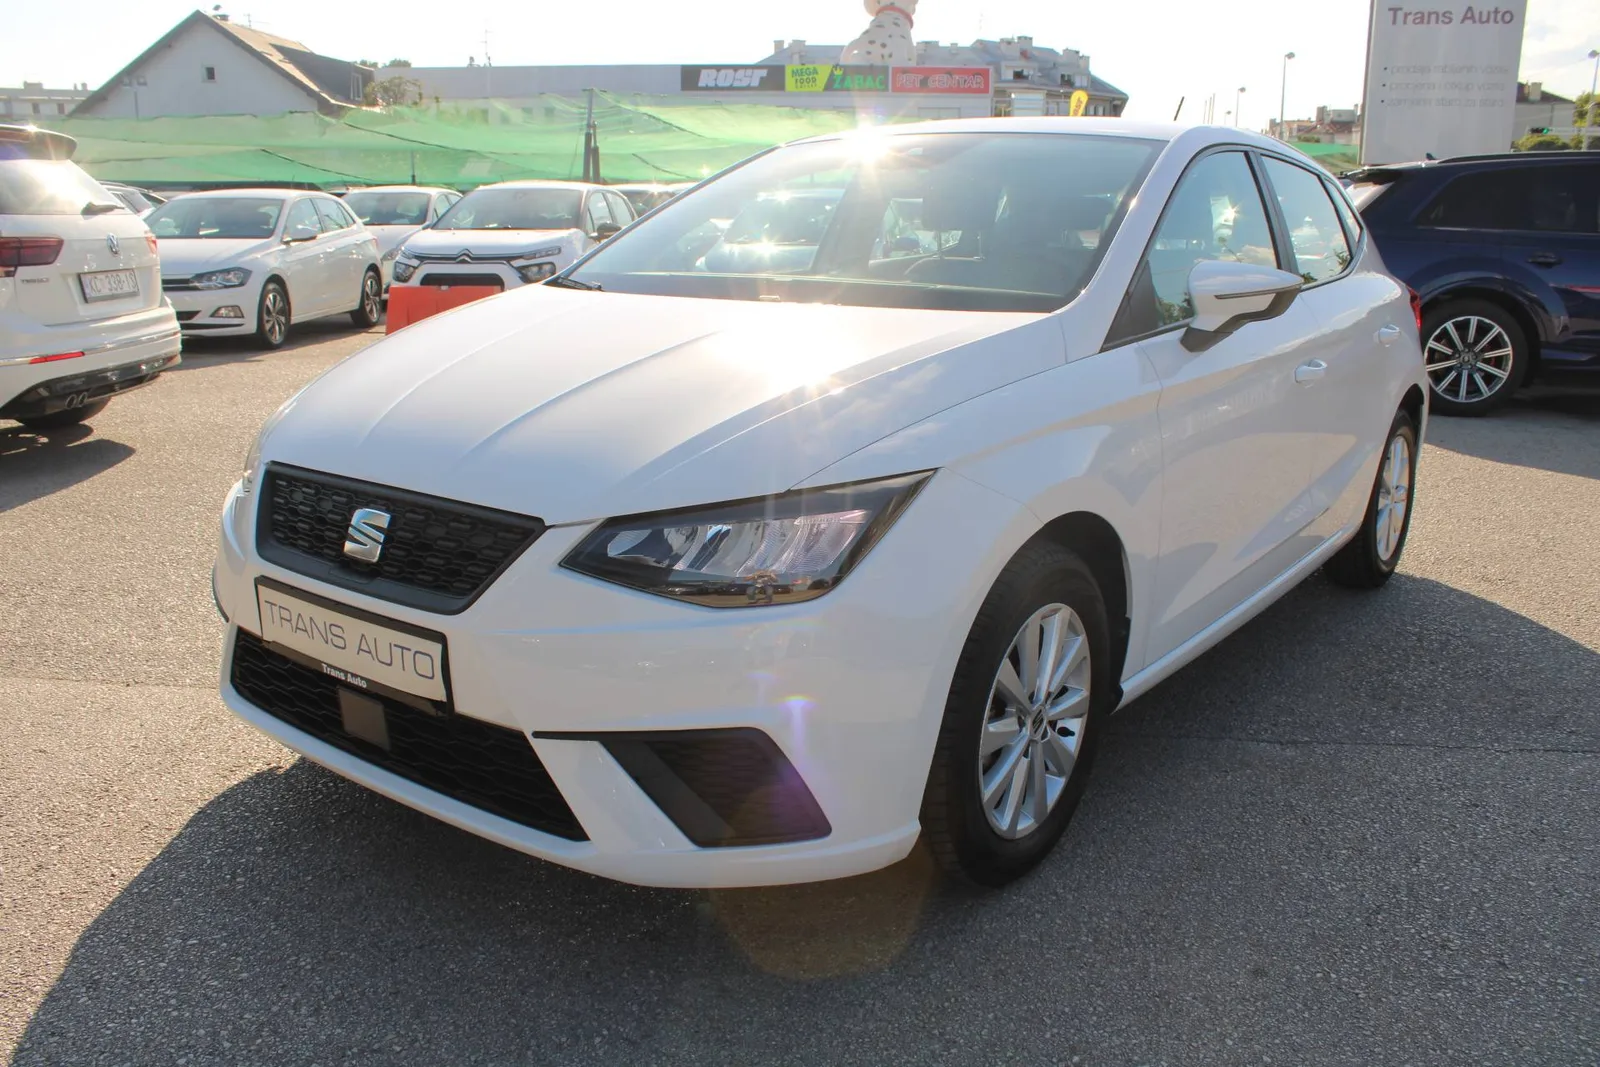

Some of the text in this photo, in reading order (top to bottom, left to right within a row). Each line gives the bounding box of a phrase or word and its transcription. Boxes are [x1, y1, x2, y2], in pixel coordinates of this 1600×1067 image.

[1388, 6, 1514, 25] Trans Auto
[698, 68, 769, 88] ROST
[791, 67, 819, 78] MEGA
[795, 77, 817, 85] FOOD
[896, 72, 985, 89] PET CENTAR
[265, 600, 435, 680] TRANS AUTO
[321, 663, 368, 689] Trans Auto
